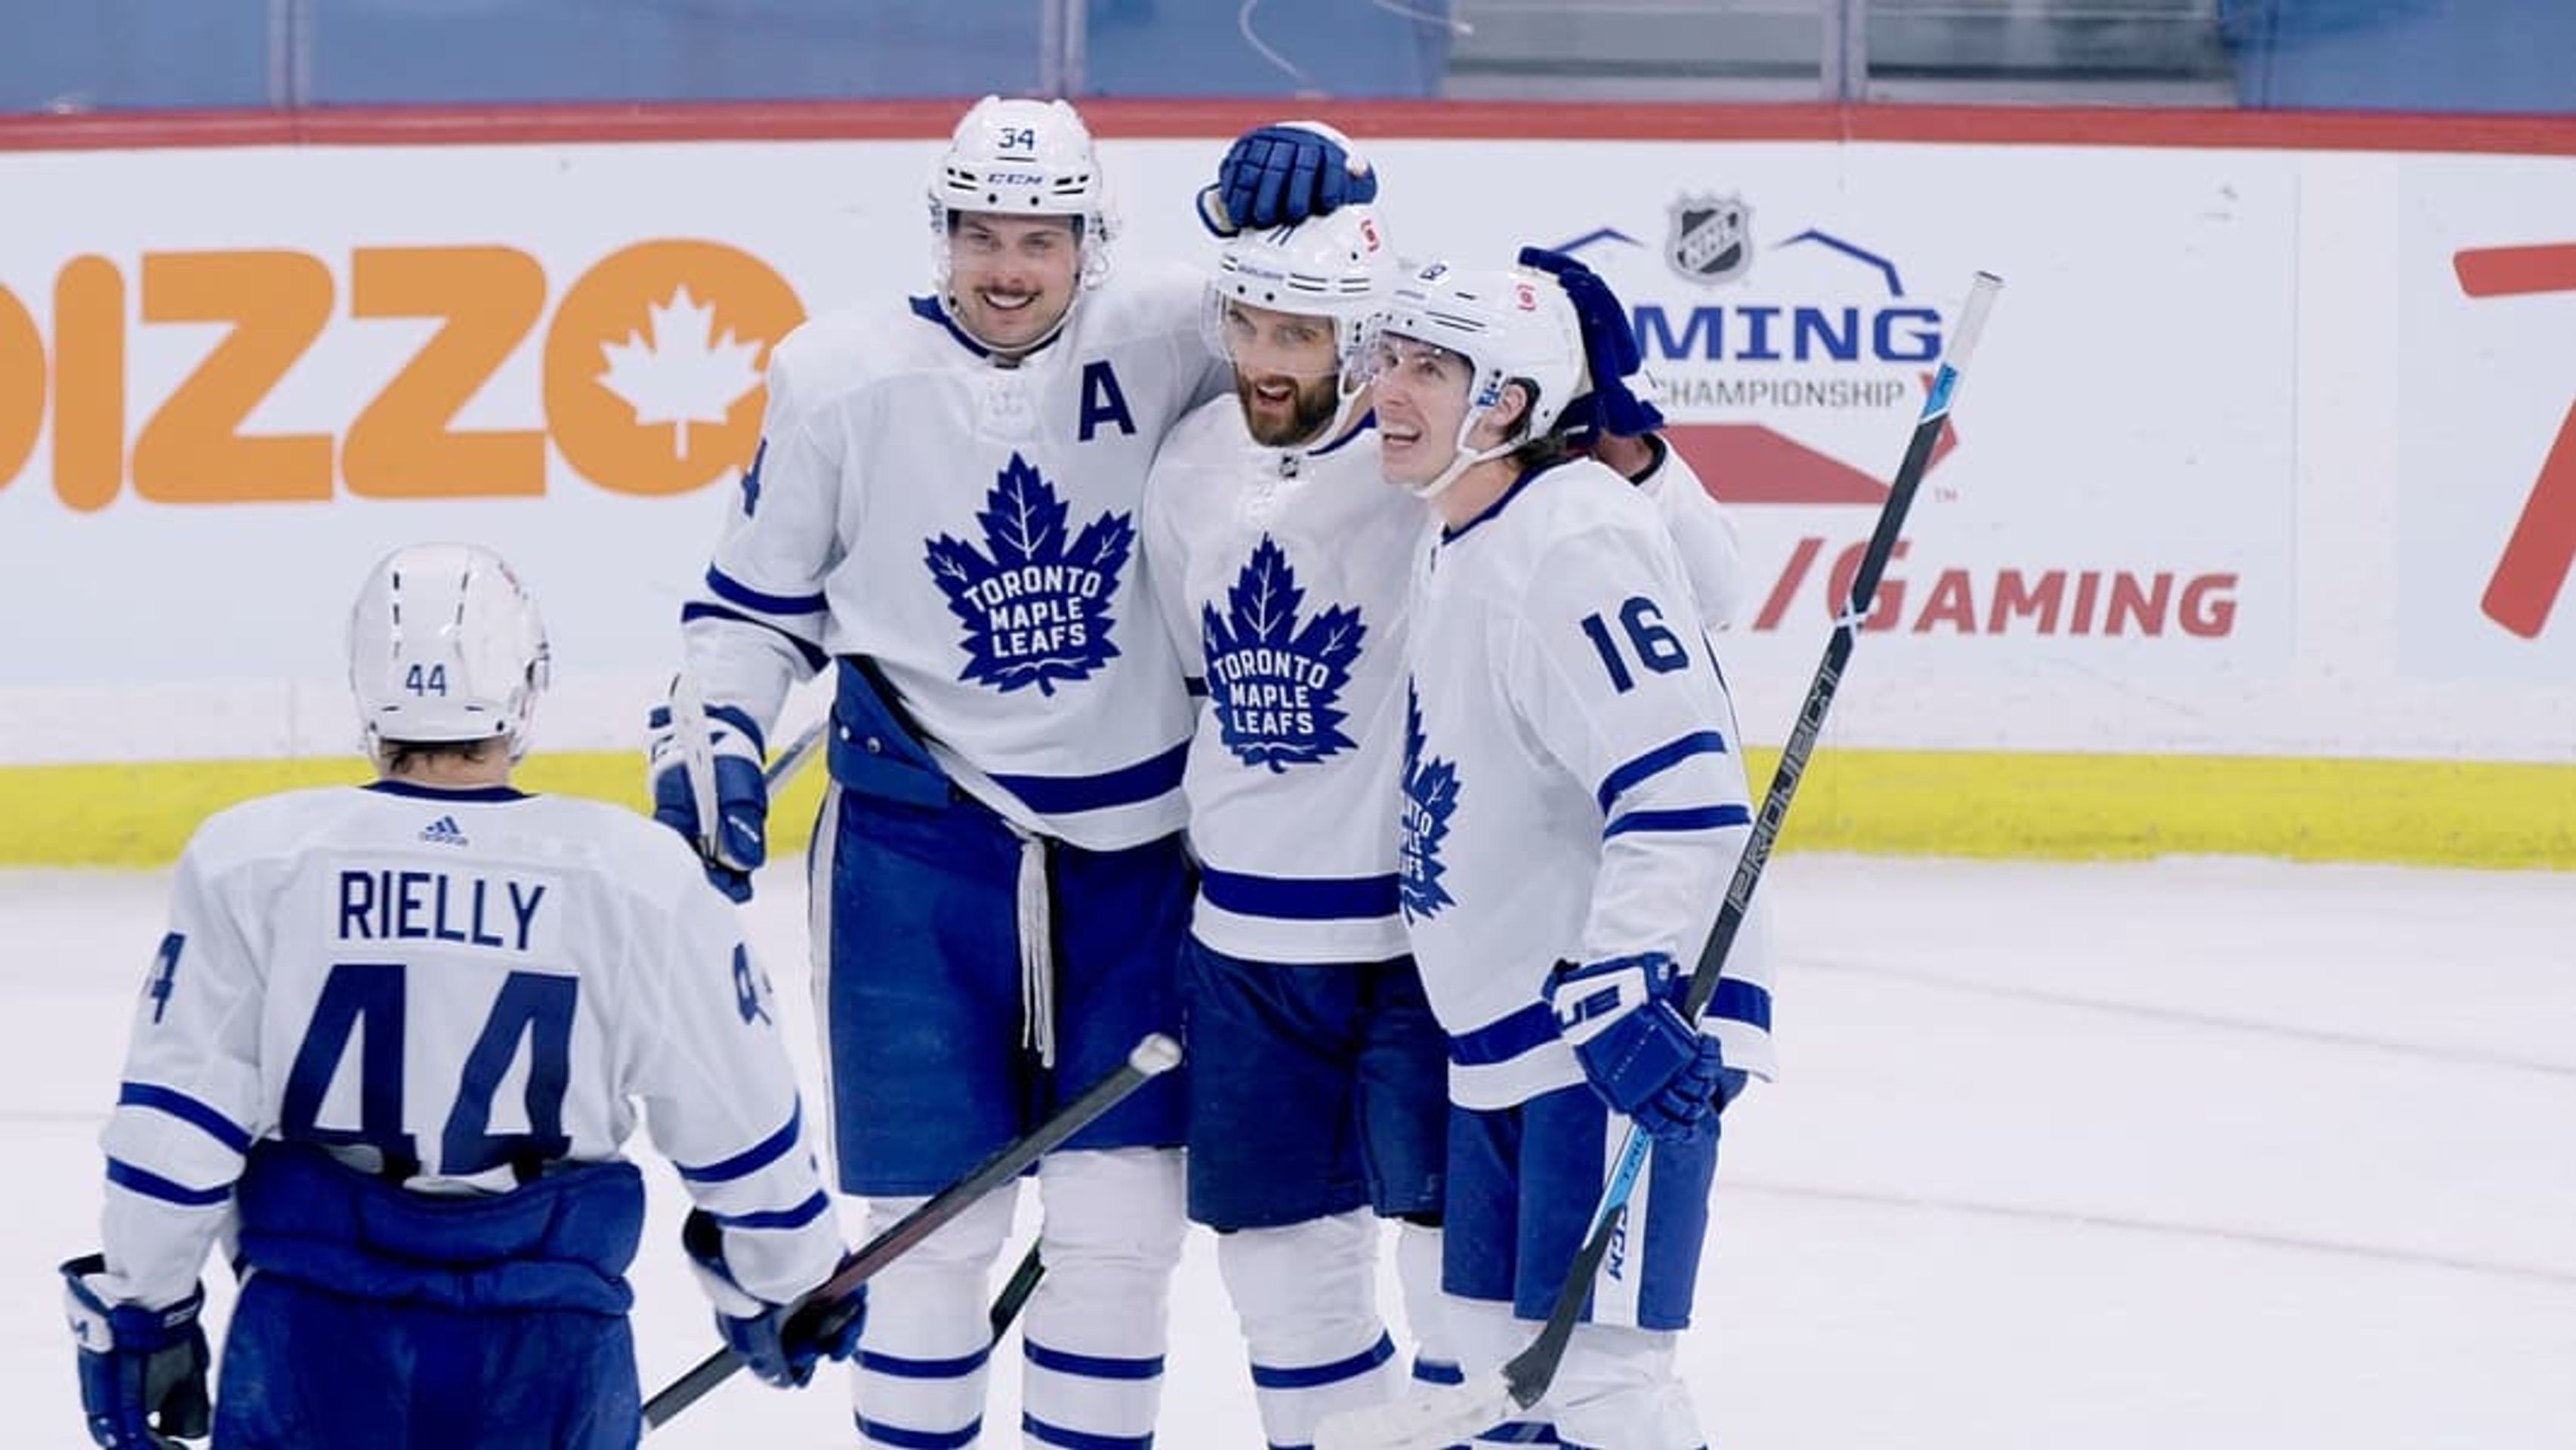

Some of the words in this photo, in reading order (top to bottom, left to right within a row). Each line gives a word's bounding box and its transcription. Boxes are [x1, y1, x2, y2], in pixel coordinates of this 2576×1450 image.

[998, 128, 1035, 150] 34
[987, 174, 1043, 185] CCM
[1633, 306, 1942, 362] MING
[1078, 359, 1137, 442] A
[963, 565, 1102, 612] TORONTO
[989, 597, 1084, 631] MAPLE
[992, 622, 1086, 658] LEAFS
[1581, 596, 1689, 694] 16
[406, 664, 446, 697] 44
[1213, 649, 1329, 690] TORONTO
[1229, 683, 1310, 708] MAPLE
[1232, 709, 1314, 736] LEAFS
[338, 871, 546, 950] RIELLY
[279, 963, 579, 1186] 44
